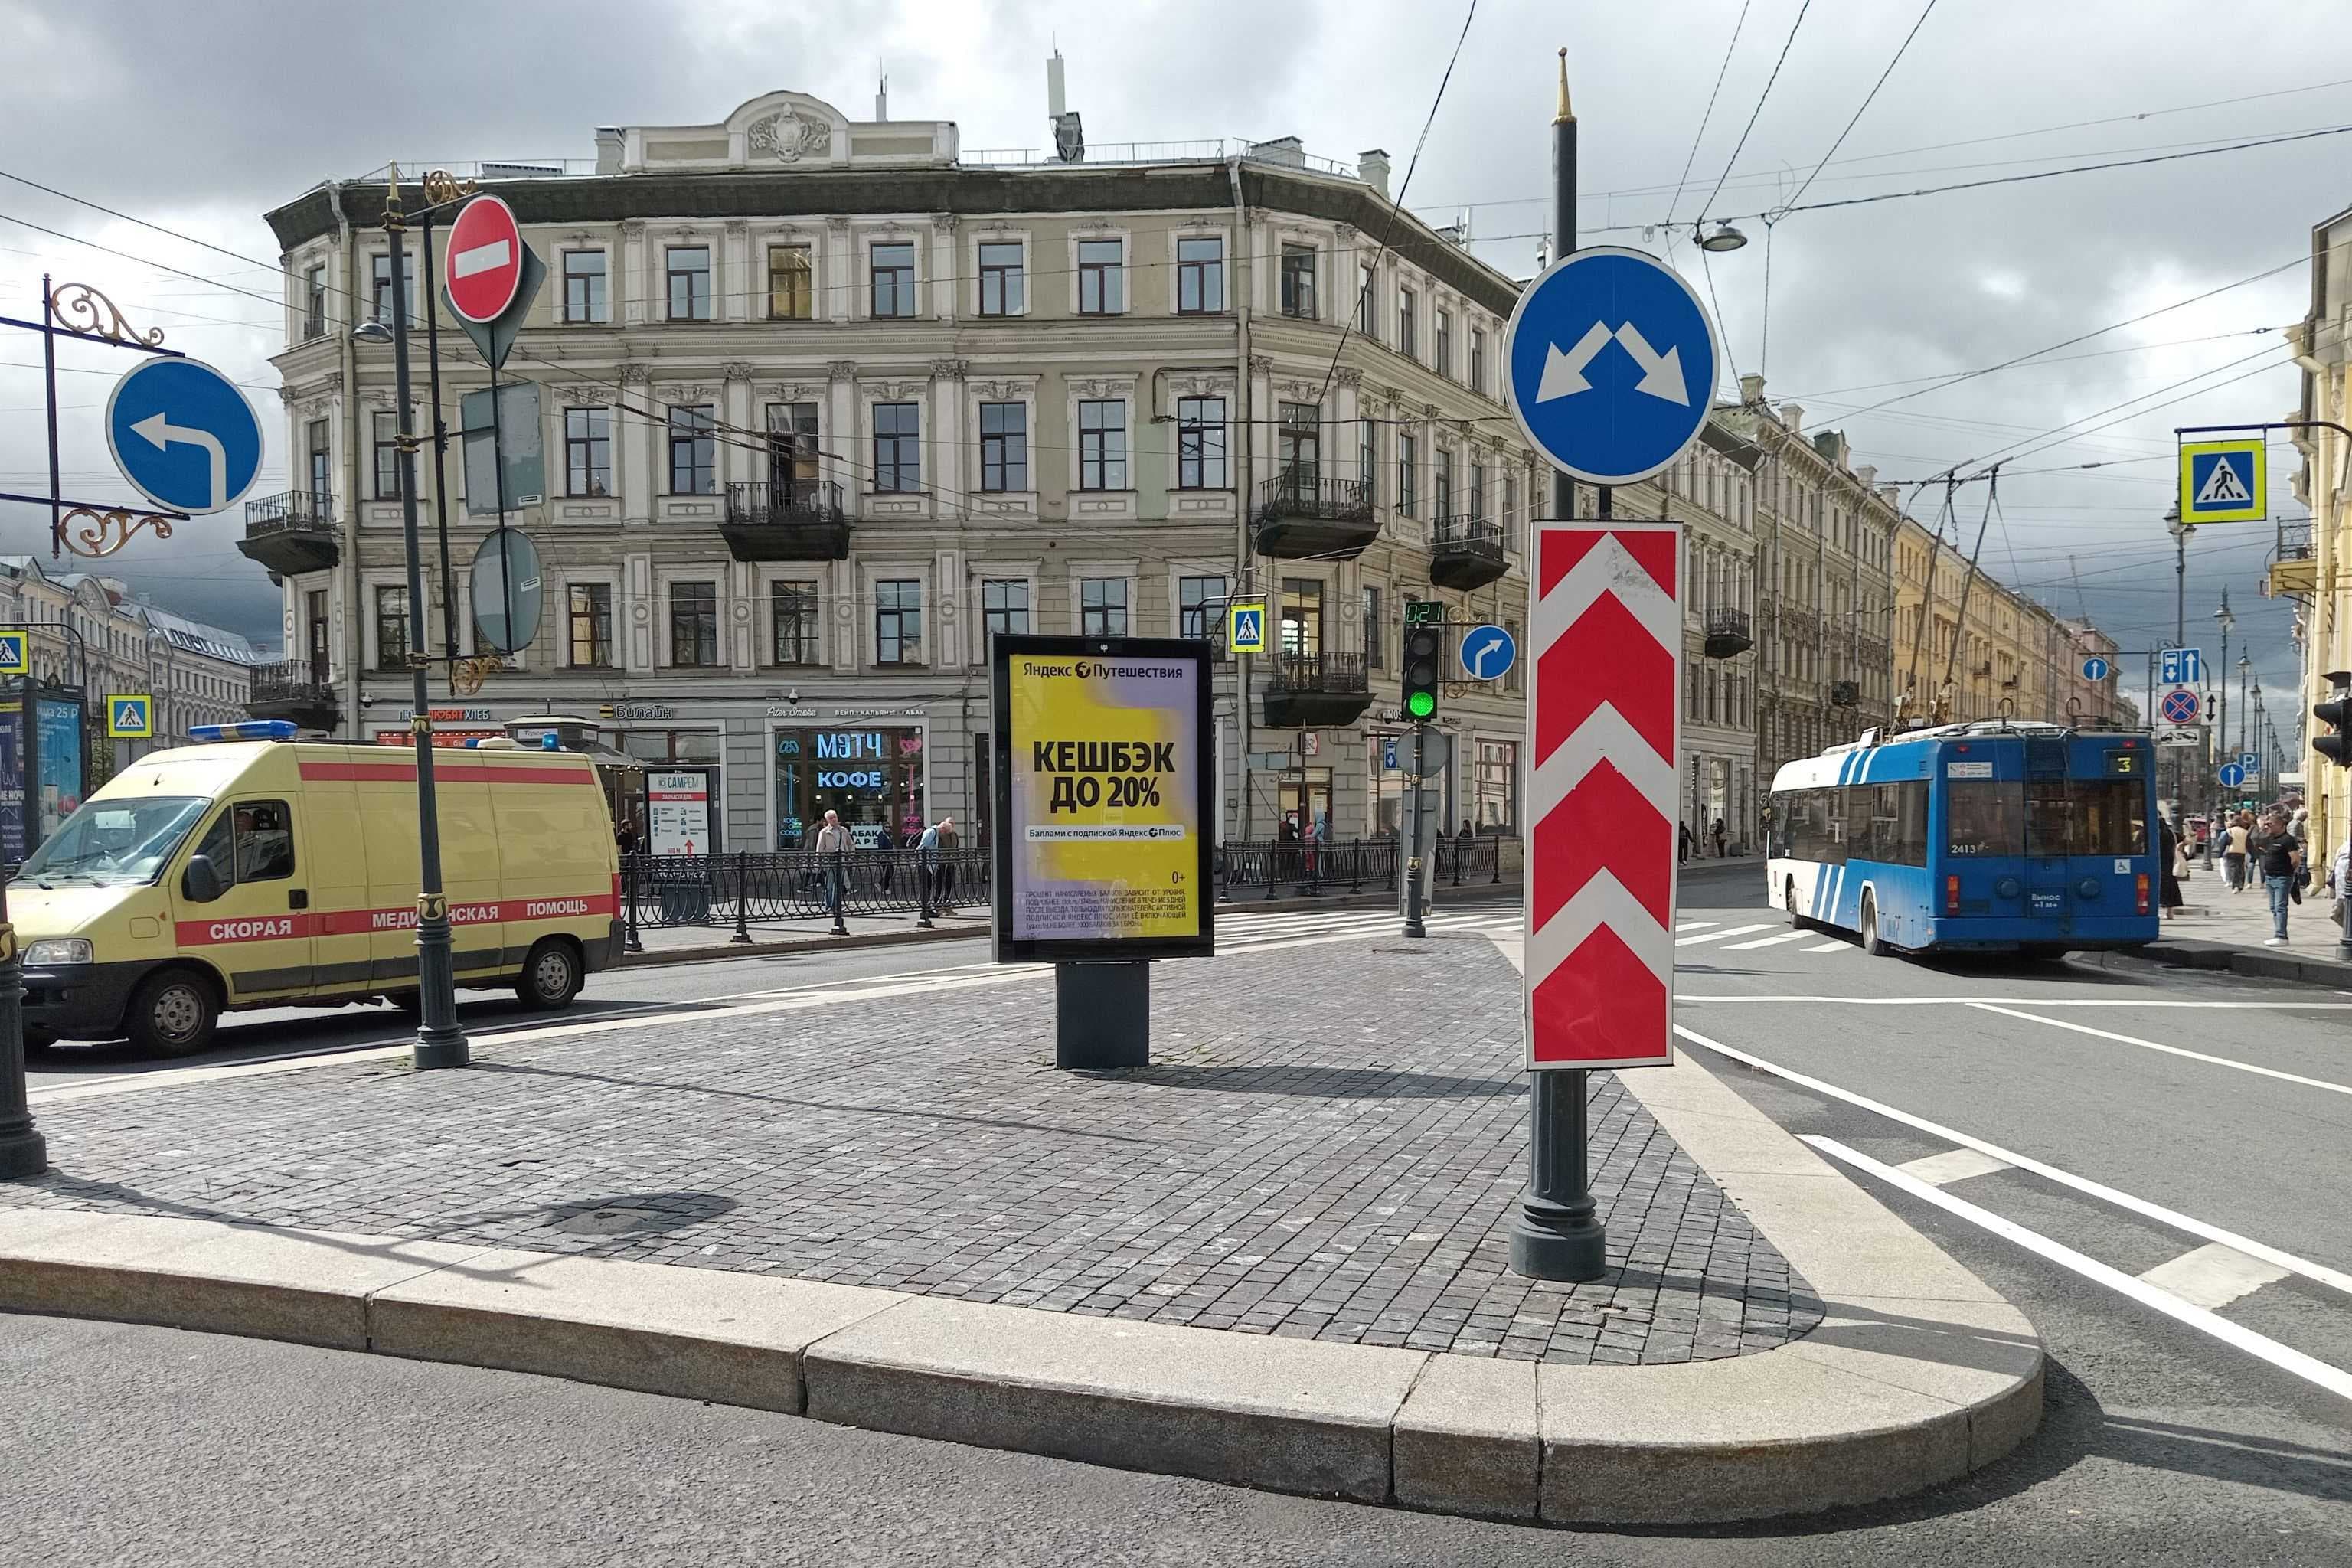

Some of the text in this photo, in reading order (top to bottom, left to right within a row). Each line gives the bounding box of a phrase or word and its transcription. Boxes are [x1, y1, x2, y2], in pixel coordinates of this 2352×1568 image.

[1023, 662, 1183, 680] Яндекс Путешествия
[57, 707, 67, 718] 25
[466, 710, 490, 720] ХЛЕБ
[616, 704, 673, 719] Билайн
[766, 706, 817, 717] Piter Smoke
[1034, 740, 1175, 773] КЕШБЭК
[2243, 756, 2255, 766] P
[2118, 756, 2132, 773] 3
[818, 771, 882, 788] КОФЕ
[1050, 776, 1160, 814] ДО 20%
[1029, 829, 1066, 838] Баллами
[1073, 829, 1117, 838] подпиской
[1119, 829, 1148, 838] Яндекс
[1951, 844, 1976, 854] 2413
[1171, 871, 1185, 884] 0+
[209, 899, 589, 940] СКОРАЯ МЕДИНСКАЯ ПОМОЩЬ
